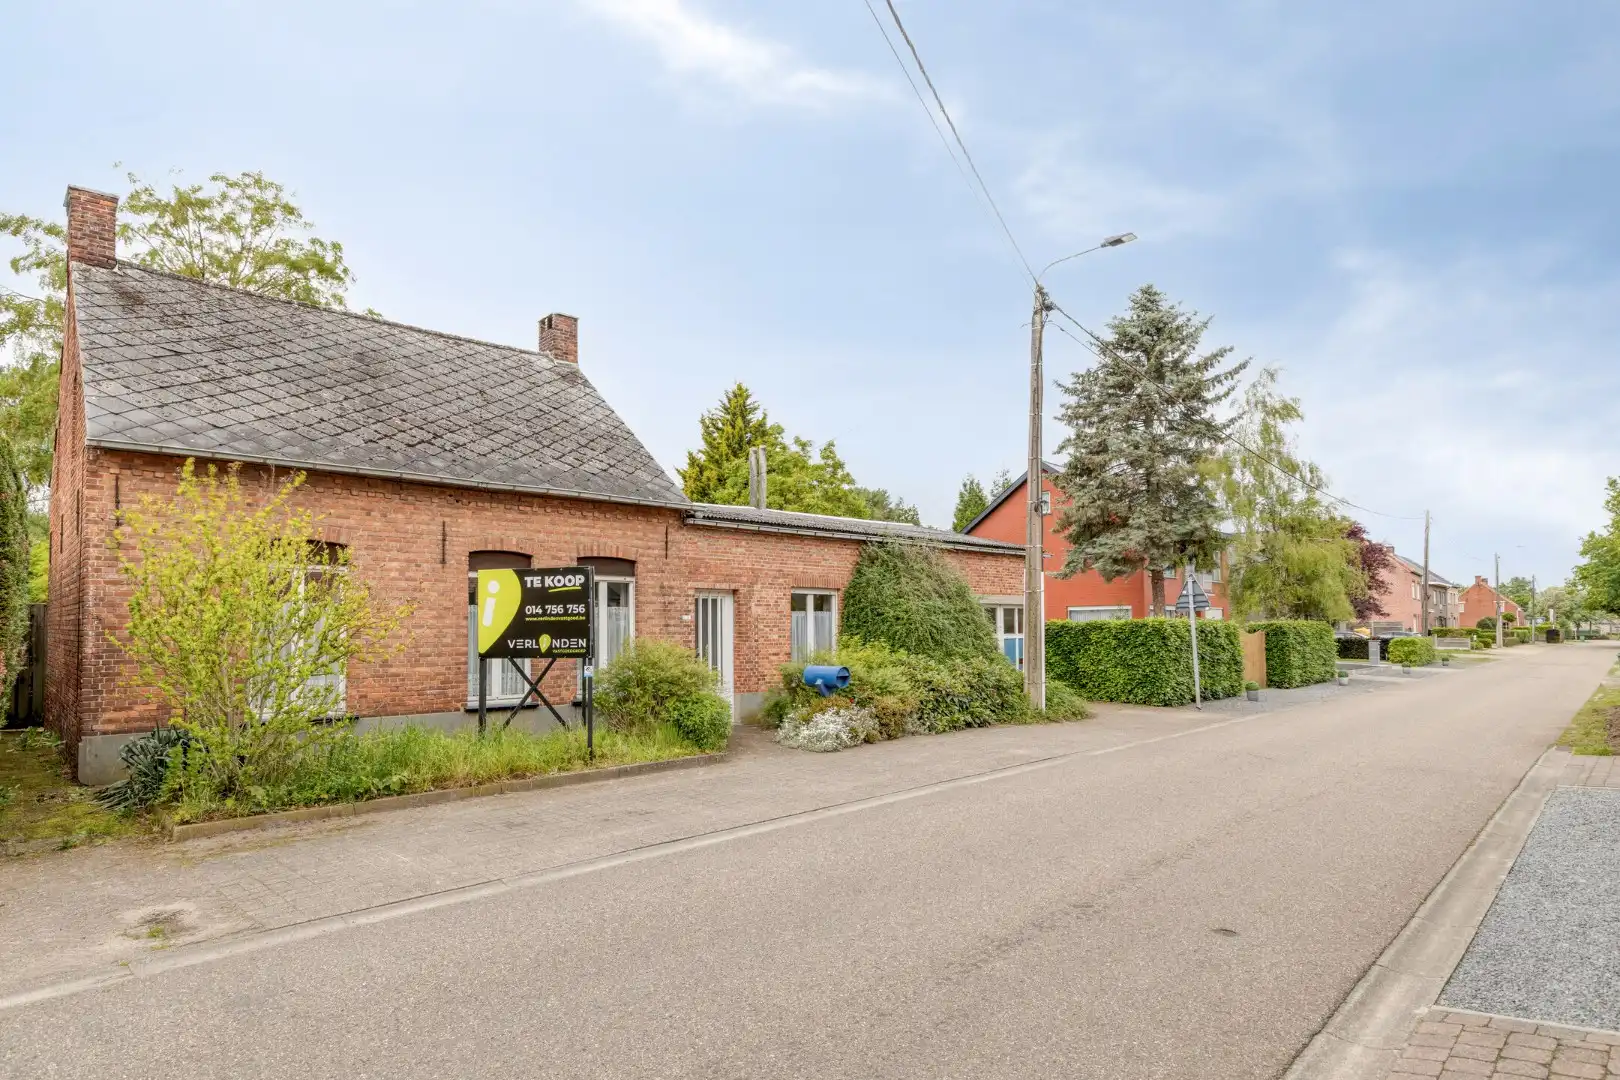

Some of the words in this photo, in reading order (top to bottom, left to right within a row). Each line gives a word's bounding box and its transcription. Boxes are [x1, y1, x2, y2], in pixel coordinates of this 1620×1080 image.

[524, 576, 542, 588] TE
[544, 575, 585, 588] KOOP
[525, 605, 543, 615] 014
[545, 604, 564, 614] 756
[566, 604, 586, 614] 756
